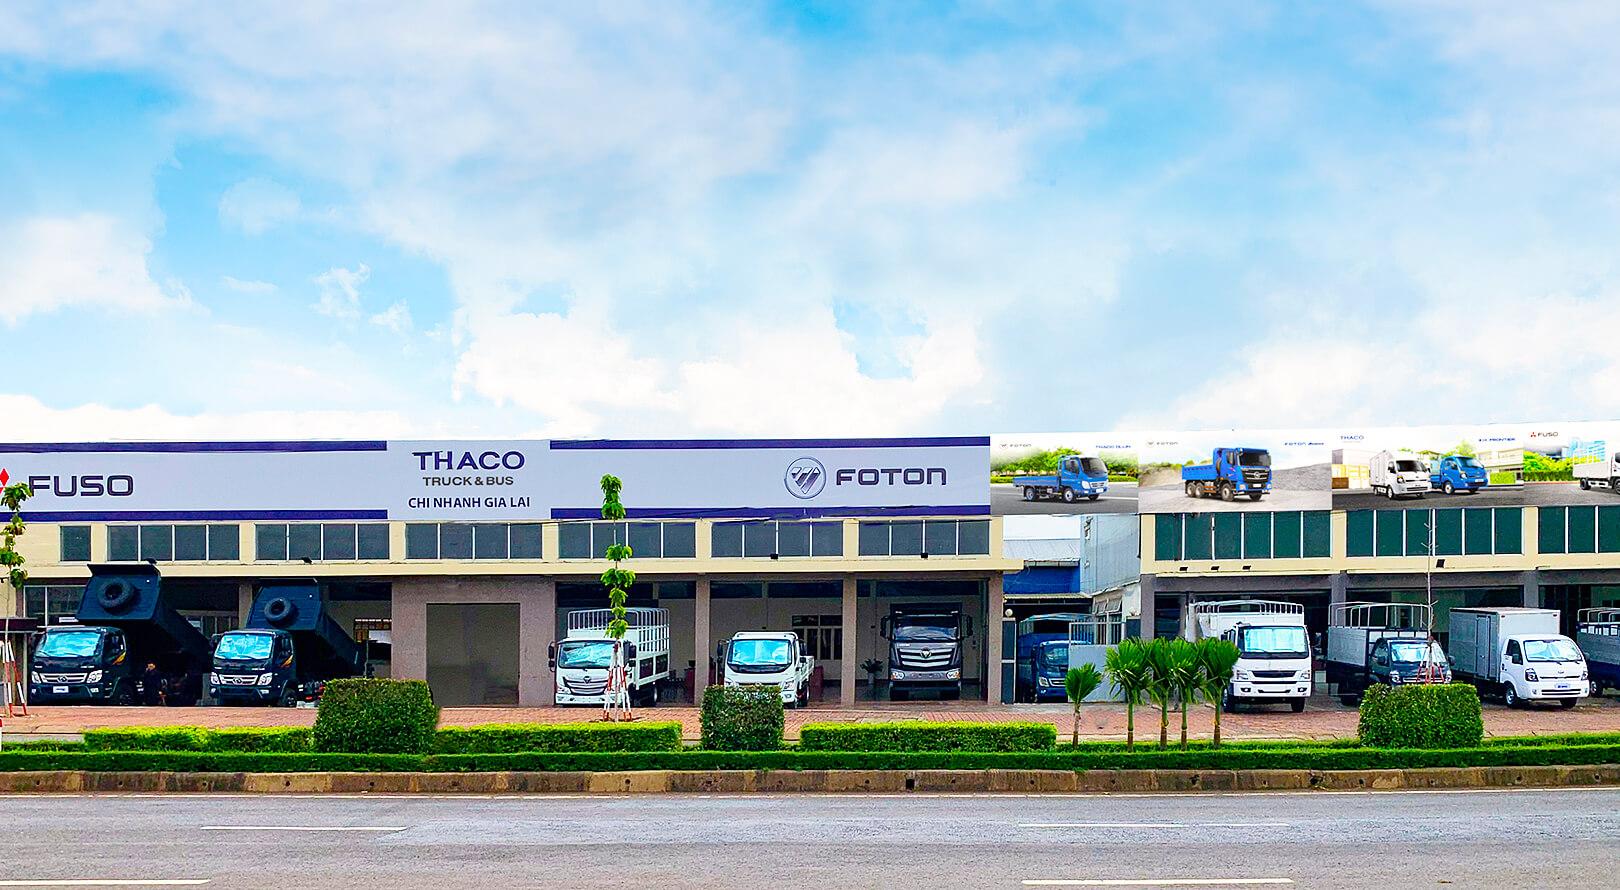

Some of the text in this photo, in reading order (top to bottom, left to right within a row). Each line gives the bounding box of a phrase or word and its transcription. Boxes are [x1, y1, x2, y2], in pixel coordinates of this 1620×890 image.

[412, 451, 525, 470] THACO
[28, 475, 134, 497] FUSO
[422, 476, 514, 486] TRUCK & BUS
[836, 468, 947, 486] FOTON
[408, 496, 530, 508] CHI NHANH GIA LAI
